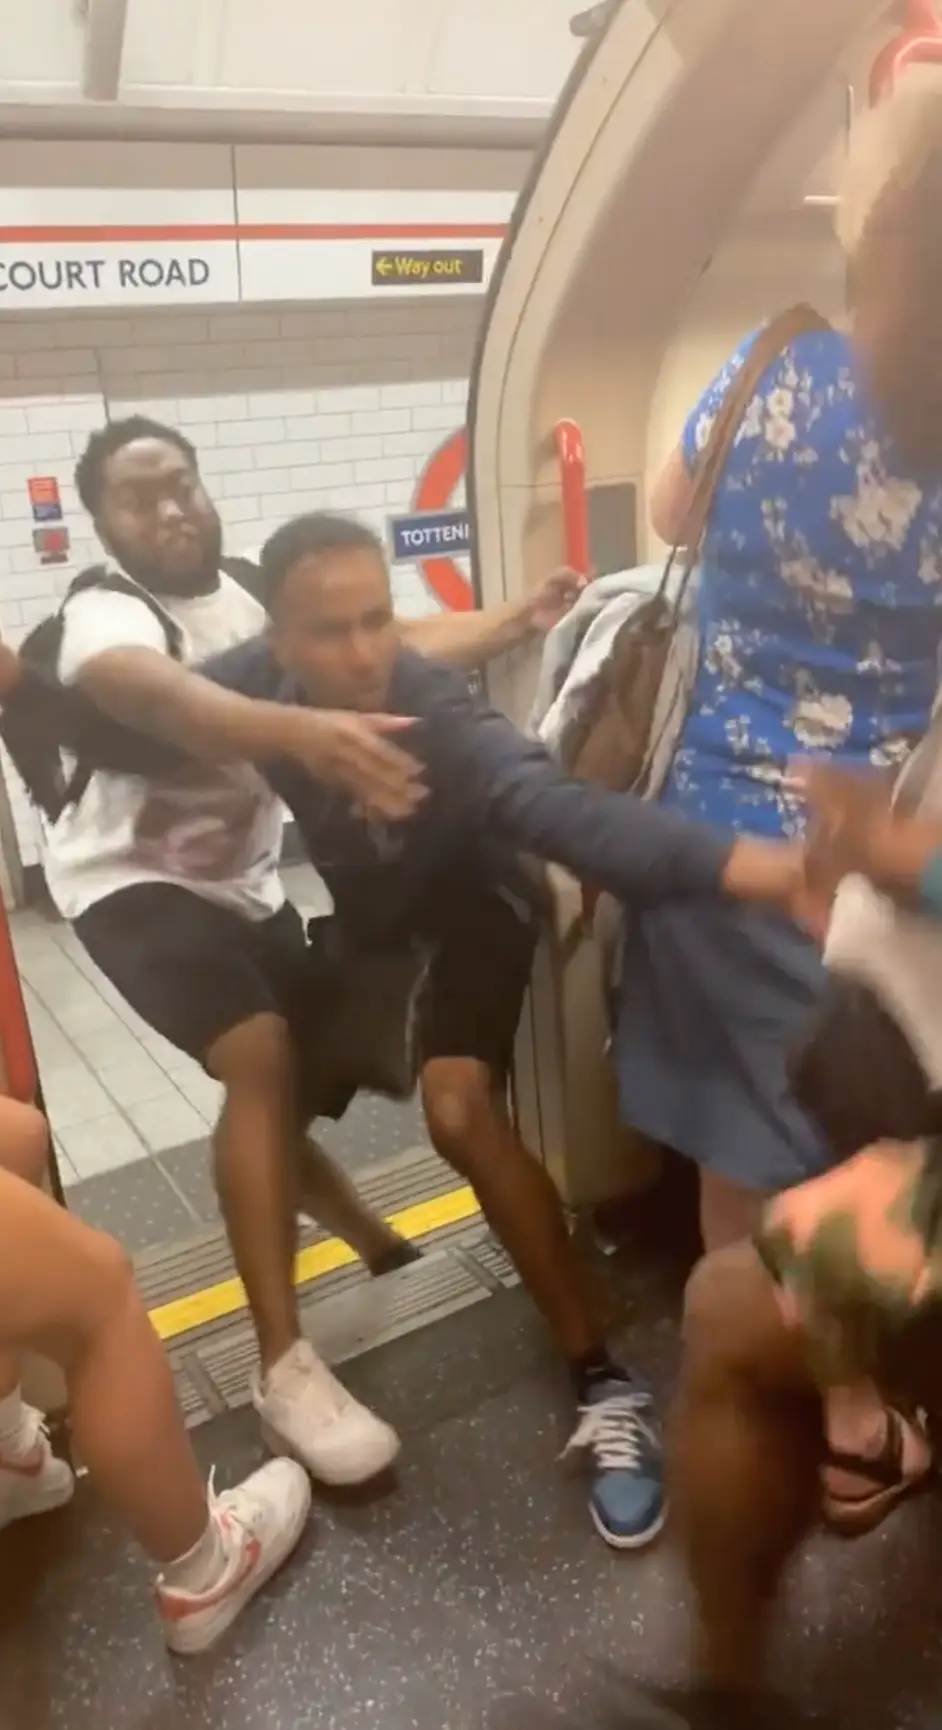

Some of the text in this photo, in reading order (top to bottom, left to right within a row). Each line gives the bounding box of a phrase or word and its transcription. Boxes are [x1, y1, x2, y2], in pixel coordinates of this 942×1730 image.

[118, 259, 209, 287] ROAD
[394, 256, 463, 279] Way out
